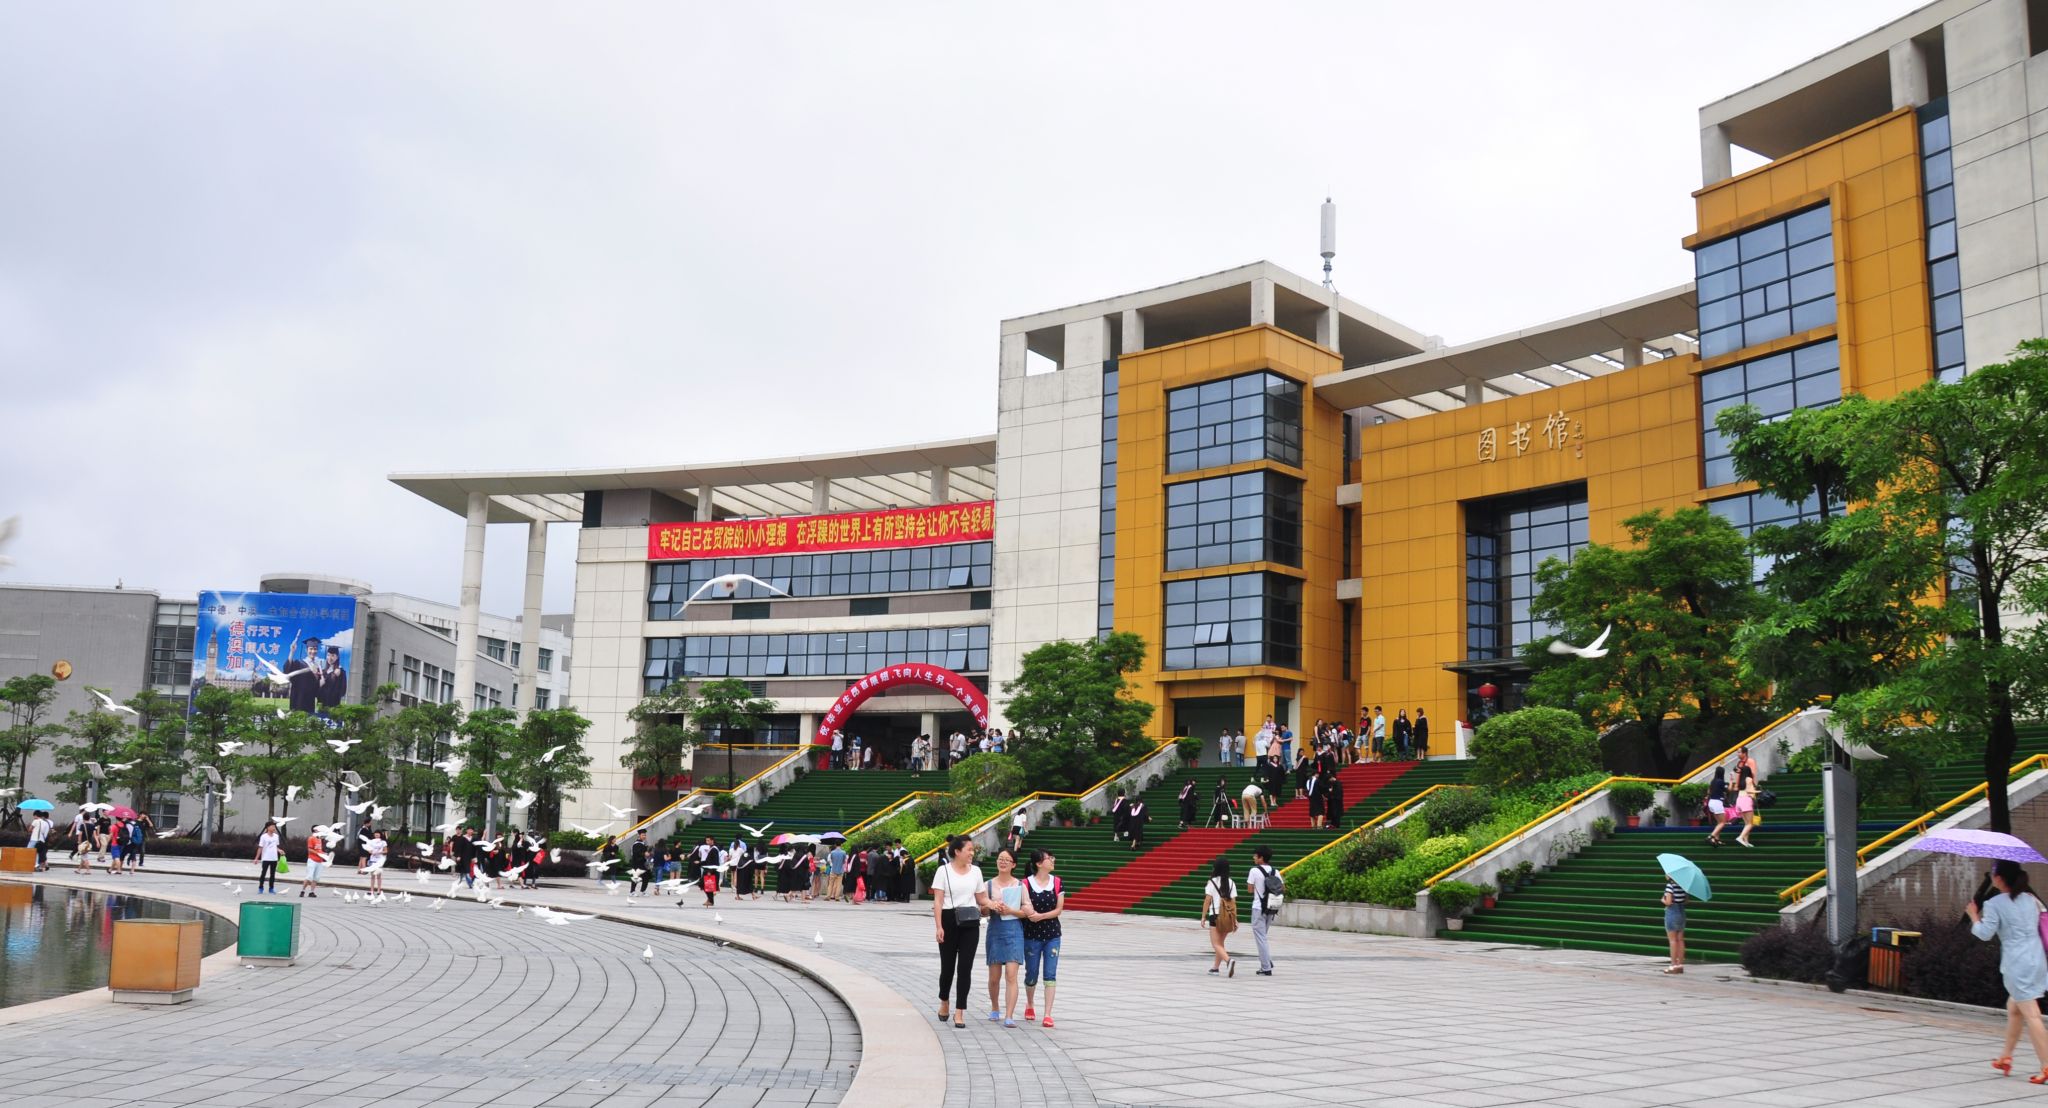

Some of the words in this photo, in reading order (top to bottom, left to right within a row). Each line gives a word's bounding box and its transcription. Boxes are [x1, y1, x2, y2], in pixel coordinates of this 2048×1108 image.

[1478, 410, 1570, 463] 图书馆
[660, 523, 788, 552] 牢记自己在贸院的小小理想
